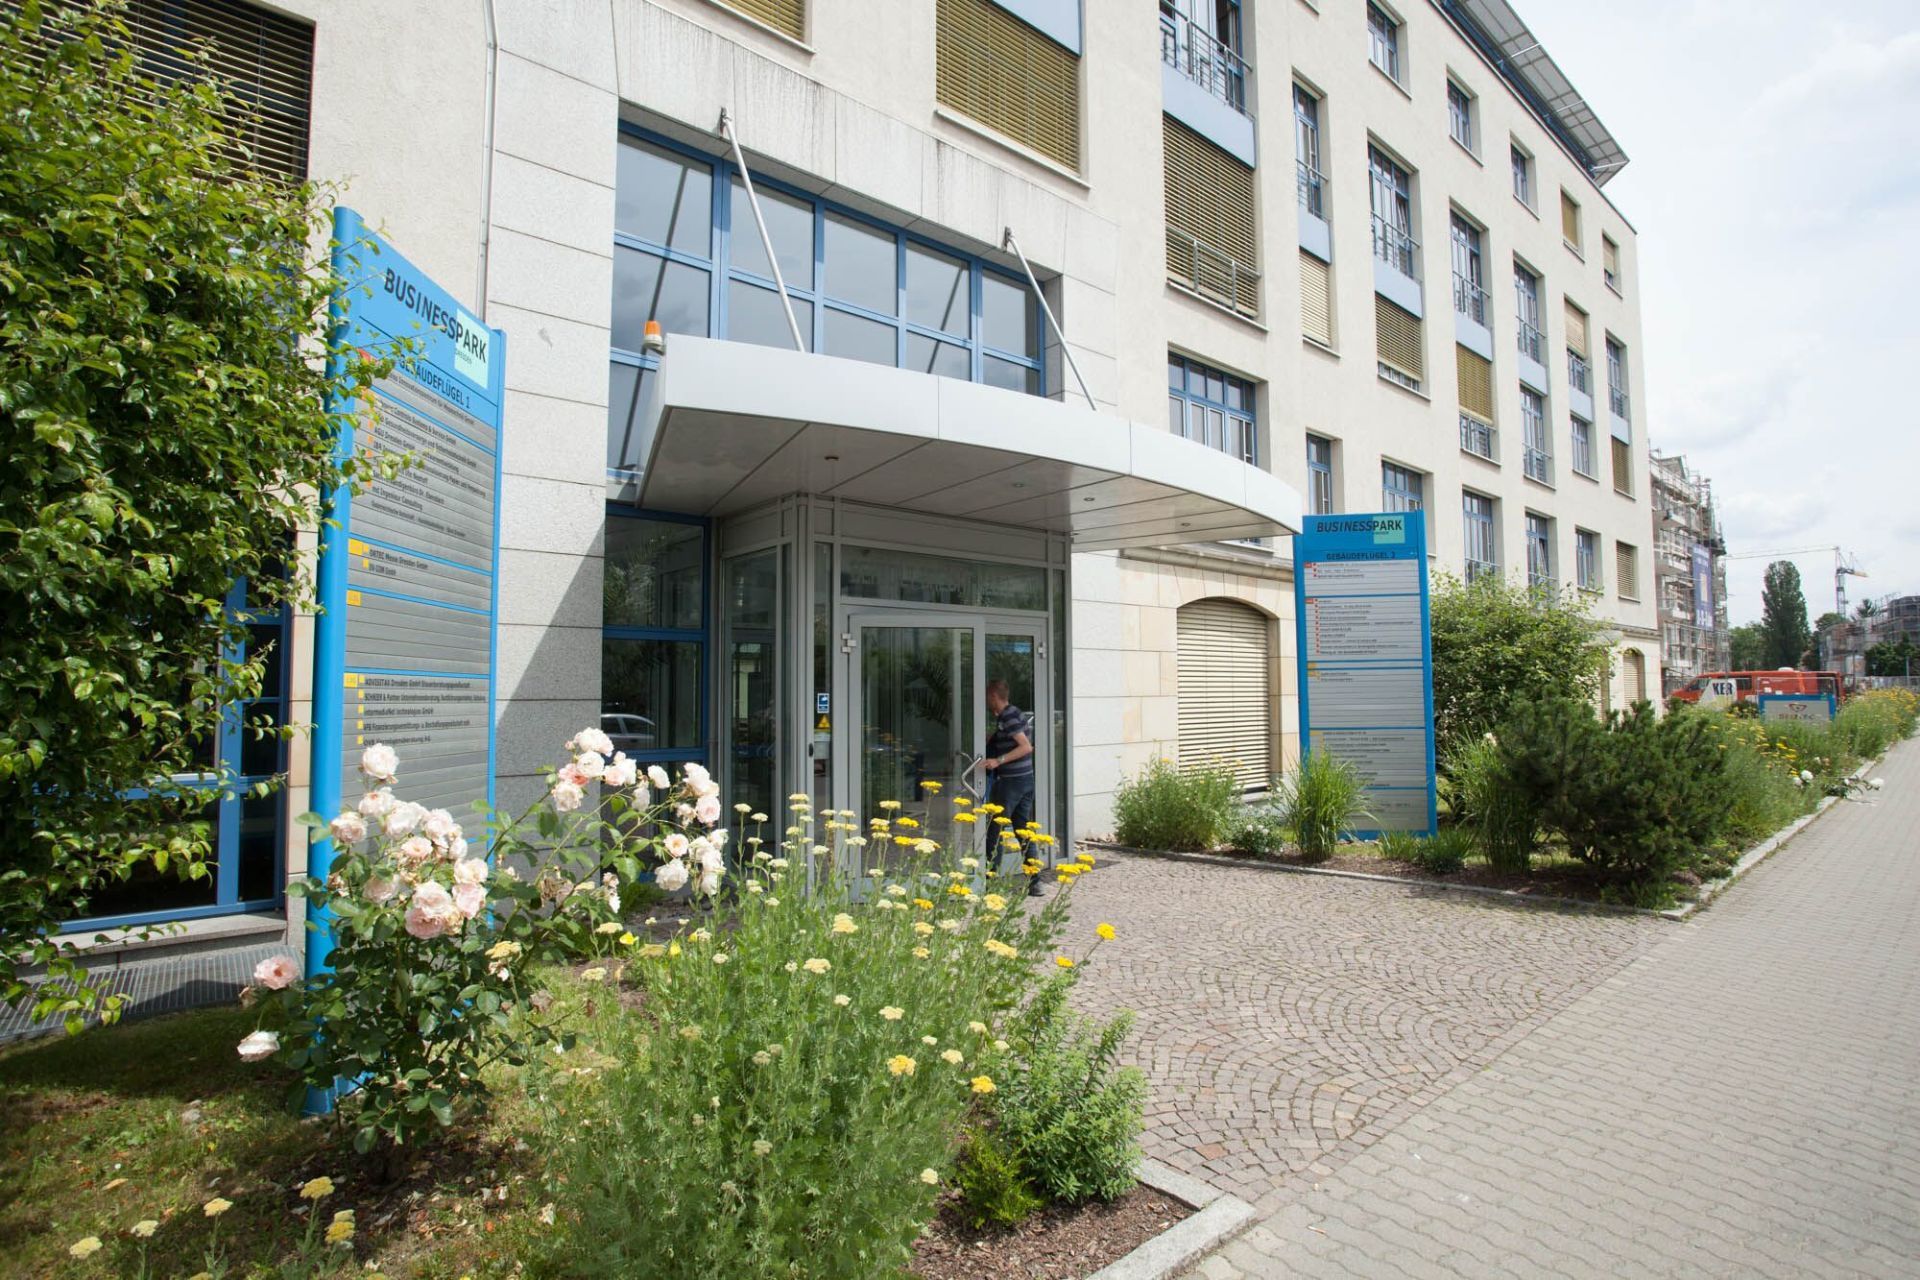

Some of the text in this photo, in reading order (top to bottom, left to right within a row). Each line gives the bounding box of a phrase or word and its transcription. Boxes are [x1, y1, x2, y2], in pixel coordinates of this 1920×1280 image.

[384, 268, 487, 363] BUSINESSPARK
[465, 396, 470, 408] 1
[1316, 519, 1402, 533] BUSINESSPARK
